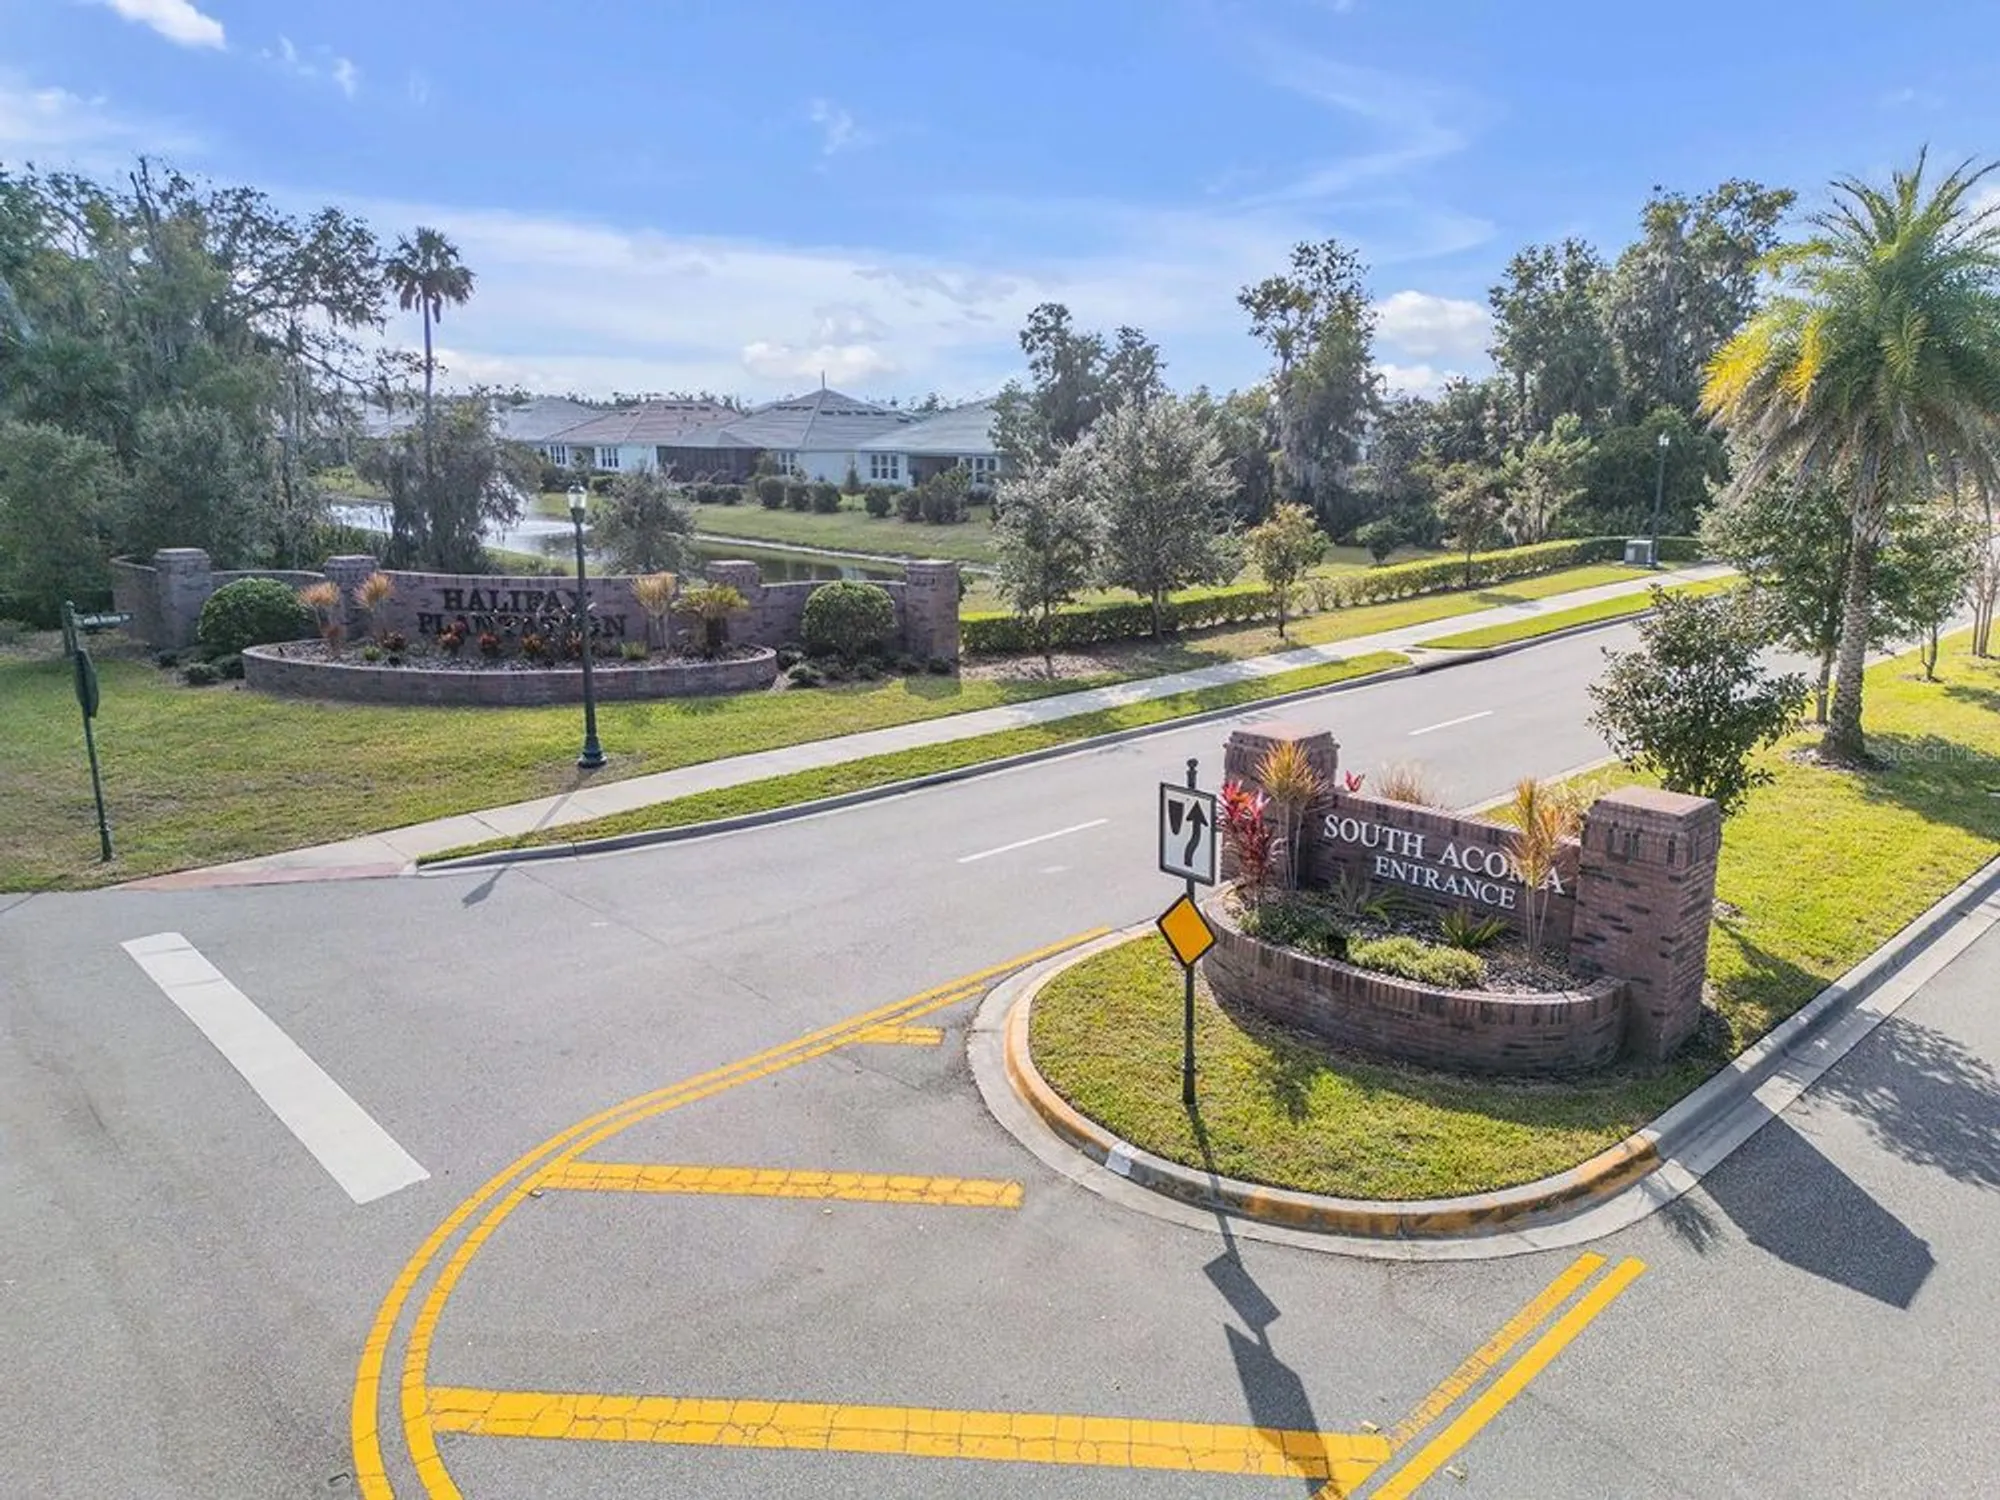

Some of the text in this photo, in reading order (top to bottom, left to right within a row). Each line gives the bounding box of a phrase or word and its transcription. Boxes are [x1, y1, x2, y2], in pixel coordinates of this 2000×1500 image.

[417, 611, 627, 637] PLANAN
[1323, 813, 1425, 859] SOUTH
[1375, 855, 1516, 910] ENTRANCE
